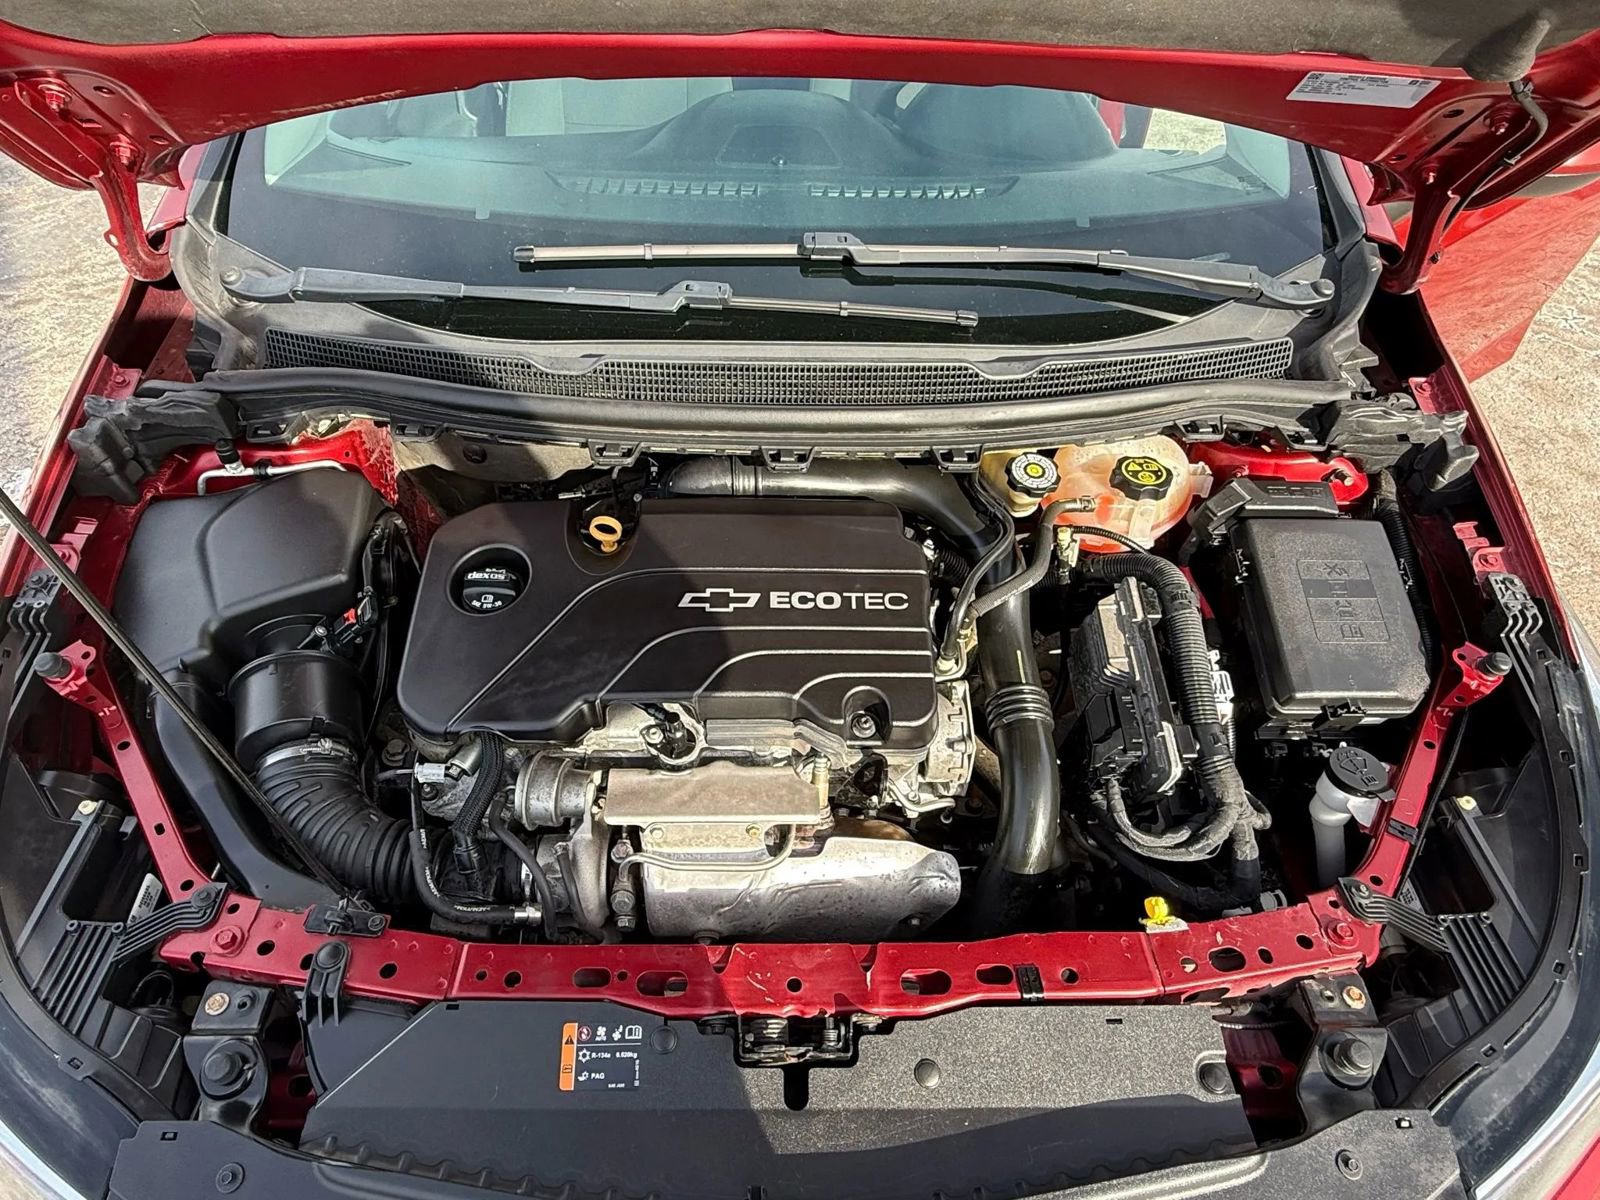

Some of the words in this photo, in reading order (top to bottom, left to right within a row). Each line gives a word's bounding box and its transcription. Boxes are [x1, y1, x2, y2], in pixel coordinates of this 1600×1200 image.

[467, 571, 507, 580] dexos
[769, 591, 909, 610] ECOTEC
[590, 1072, 605, 1080] PAG
